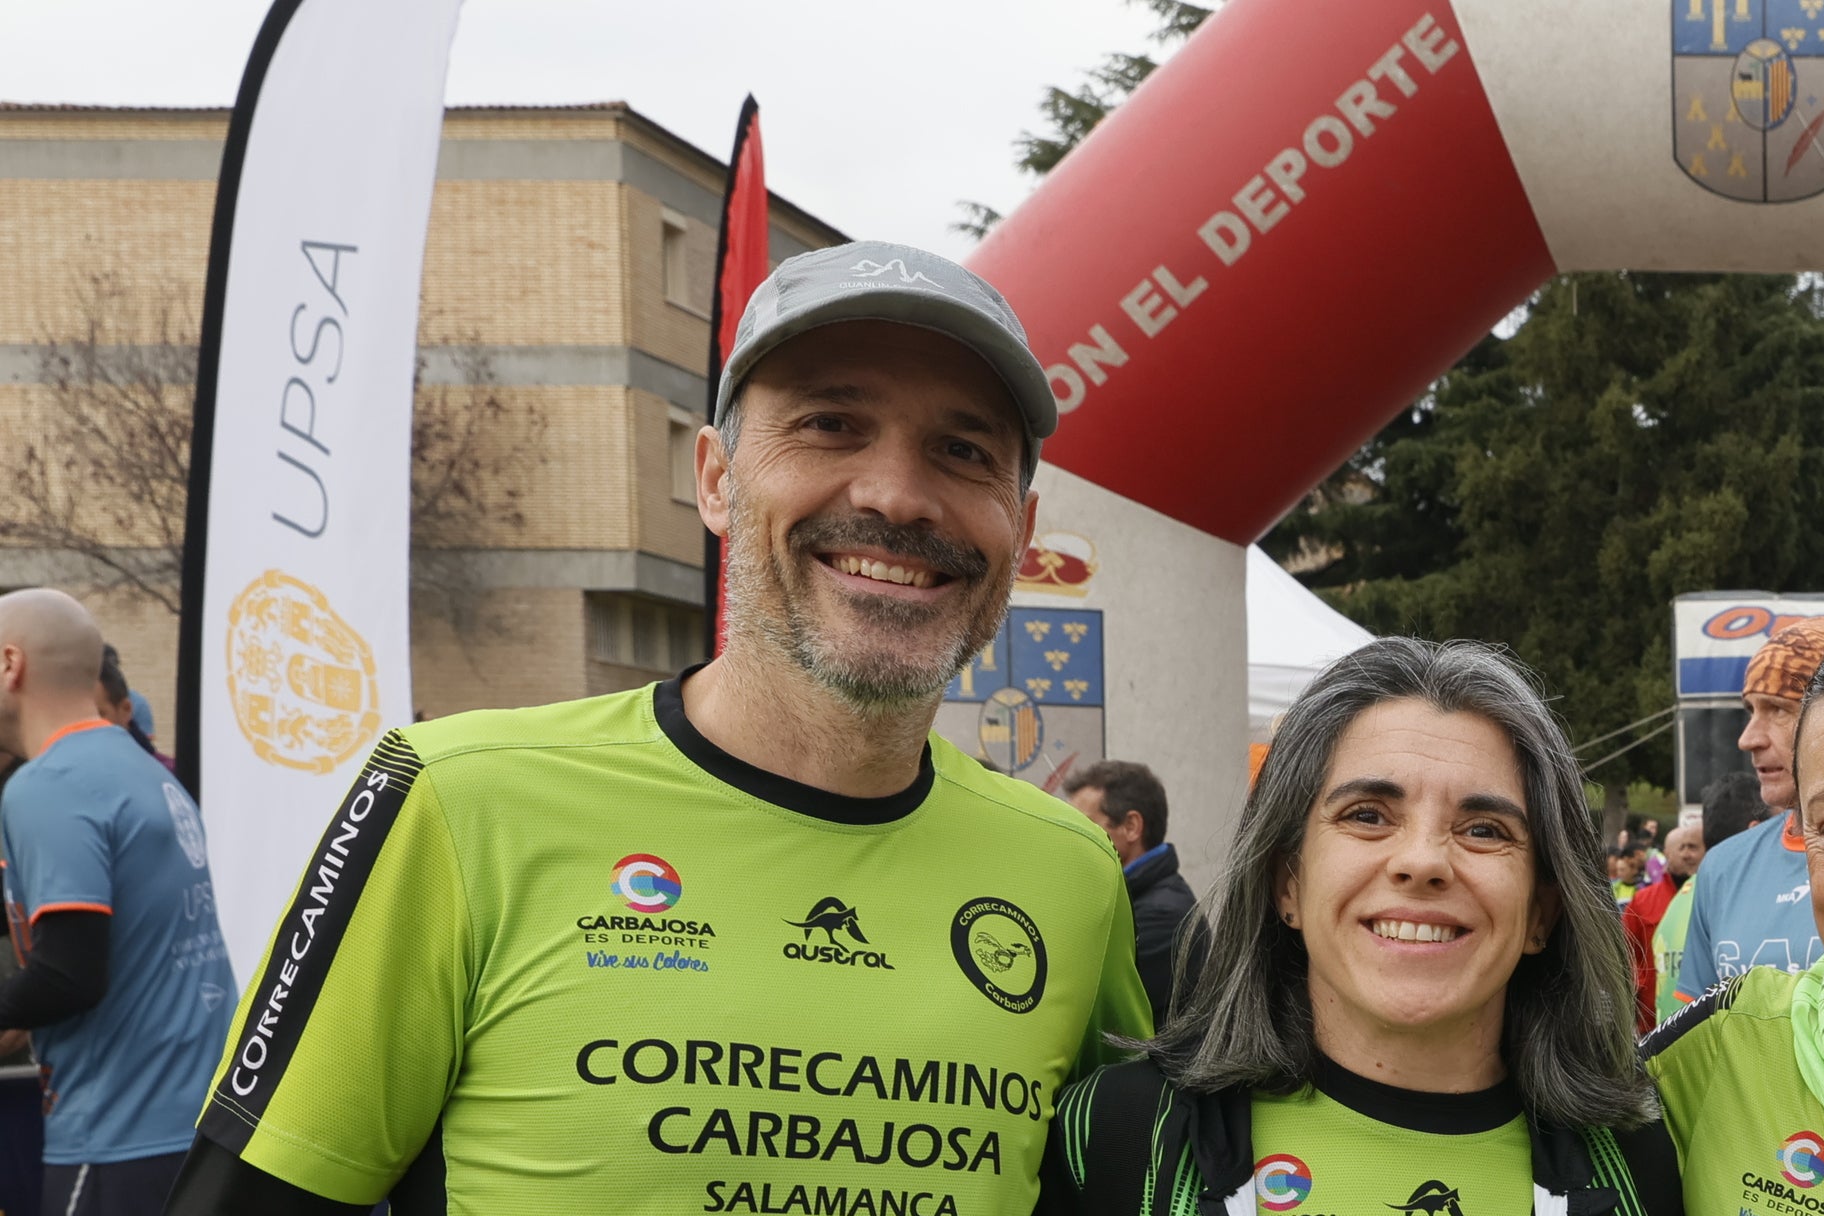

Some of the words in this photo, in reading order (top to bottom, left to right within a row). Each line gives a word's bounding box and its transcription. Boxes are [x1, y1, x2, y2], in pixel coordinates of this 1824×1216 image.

[1043, 323, 1129, 415] ON
[1119, 265, 1208, 338] EL
[1197, 13, 1460, 267] DEPORTE
[272, 240, 358, 540] UPSA
[231, 769, 390, 1097] CORRECAMINOS
[577, 916, 716, 938] CARBAJOSA
[584, 933, 609, 943] ES
[622, 933, 710, 949] DEPORTE
[958, 901, 1041, 944] CORRECAMINOS
[622, 953, 650, 969] sus
[984, 981, 1035, 1013] Carbajosa
[575, 1038, 1043, 1122] CORRECAMINOS
[647, 1106, 1001, 1176] CARBAJOSA
[1742, 1190, 1762, 1204] ES
